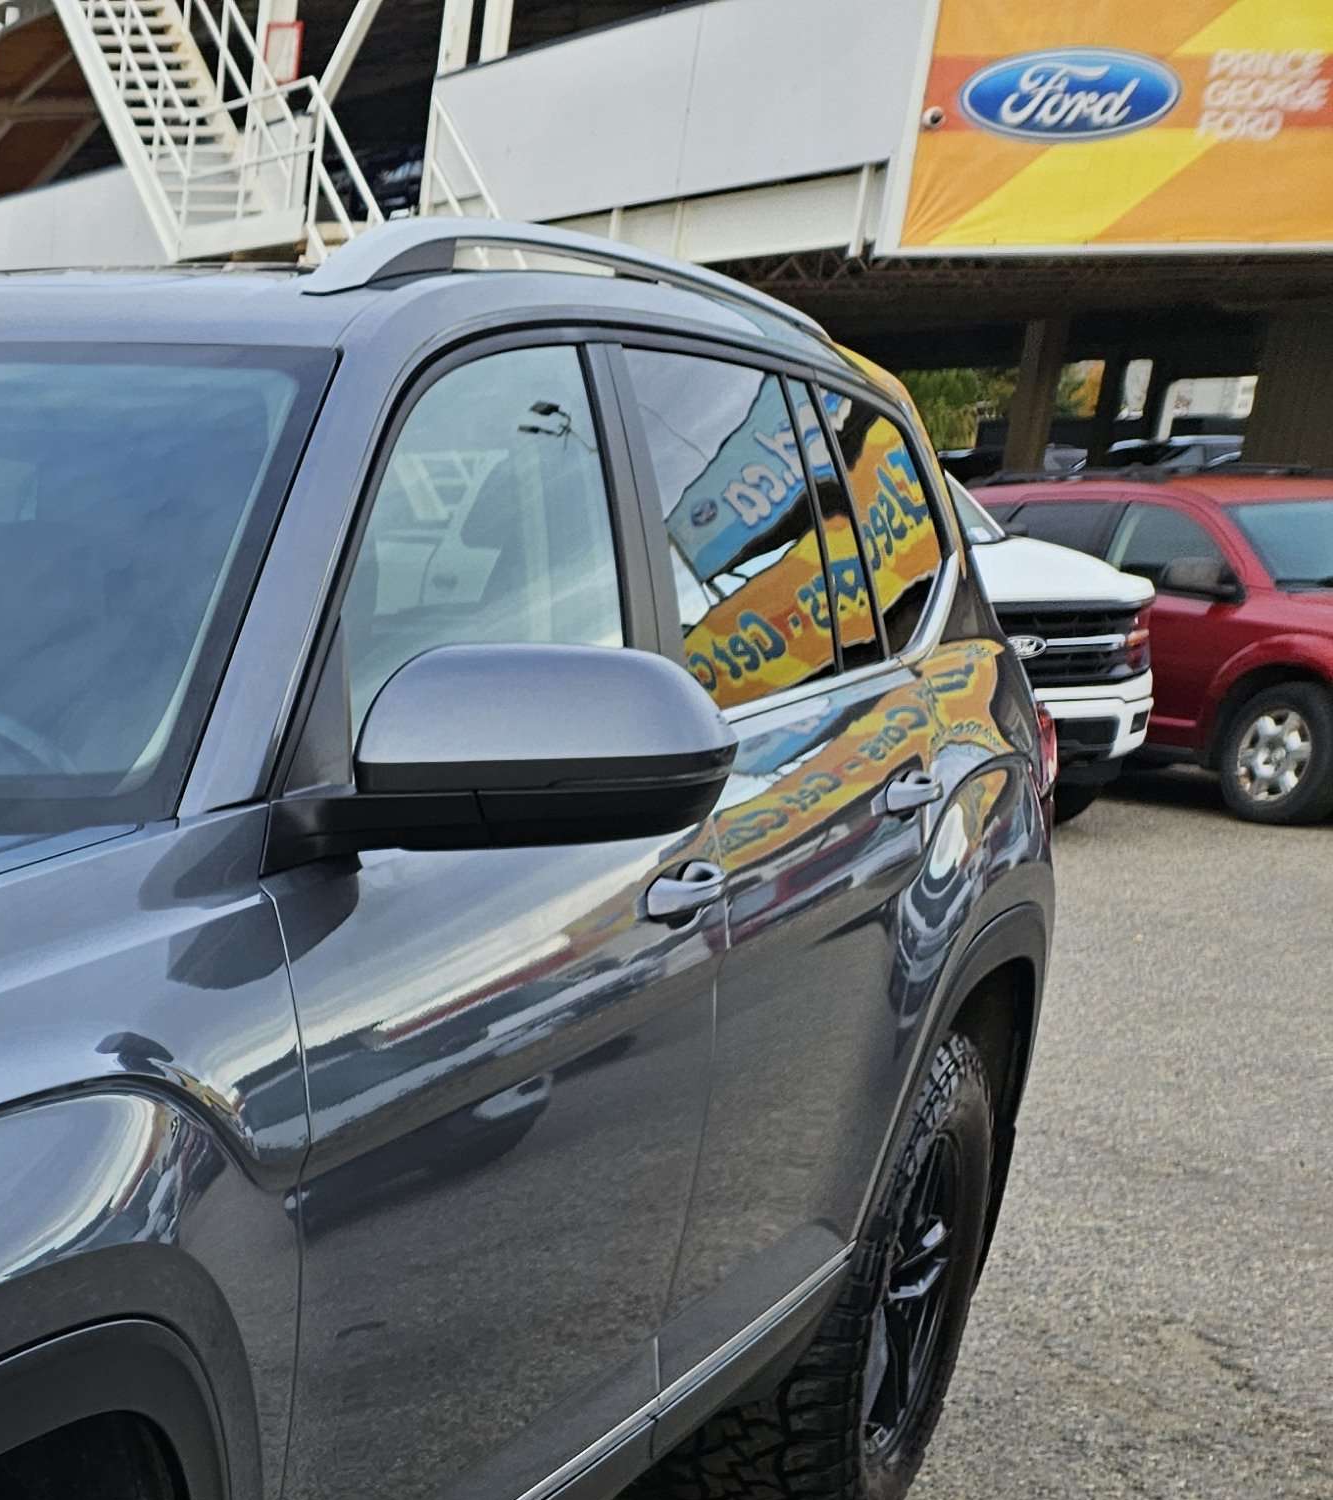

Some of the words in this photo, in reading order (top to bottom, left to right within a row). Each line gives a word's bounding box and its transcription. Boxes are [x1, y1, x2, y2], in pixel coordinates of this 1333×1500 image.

[1207, 48, 1326, 77] PRINCE
[999, 62, 1140, 128] Ford
[1203, 79, 1331, 112] GEORGE
[1196, 111, 1285, 139] FORD
